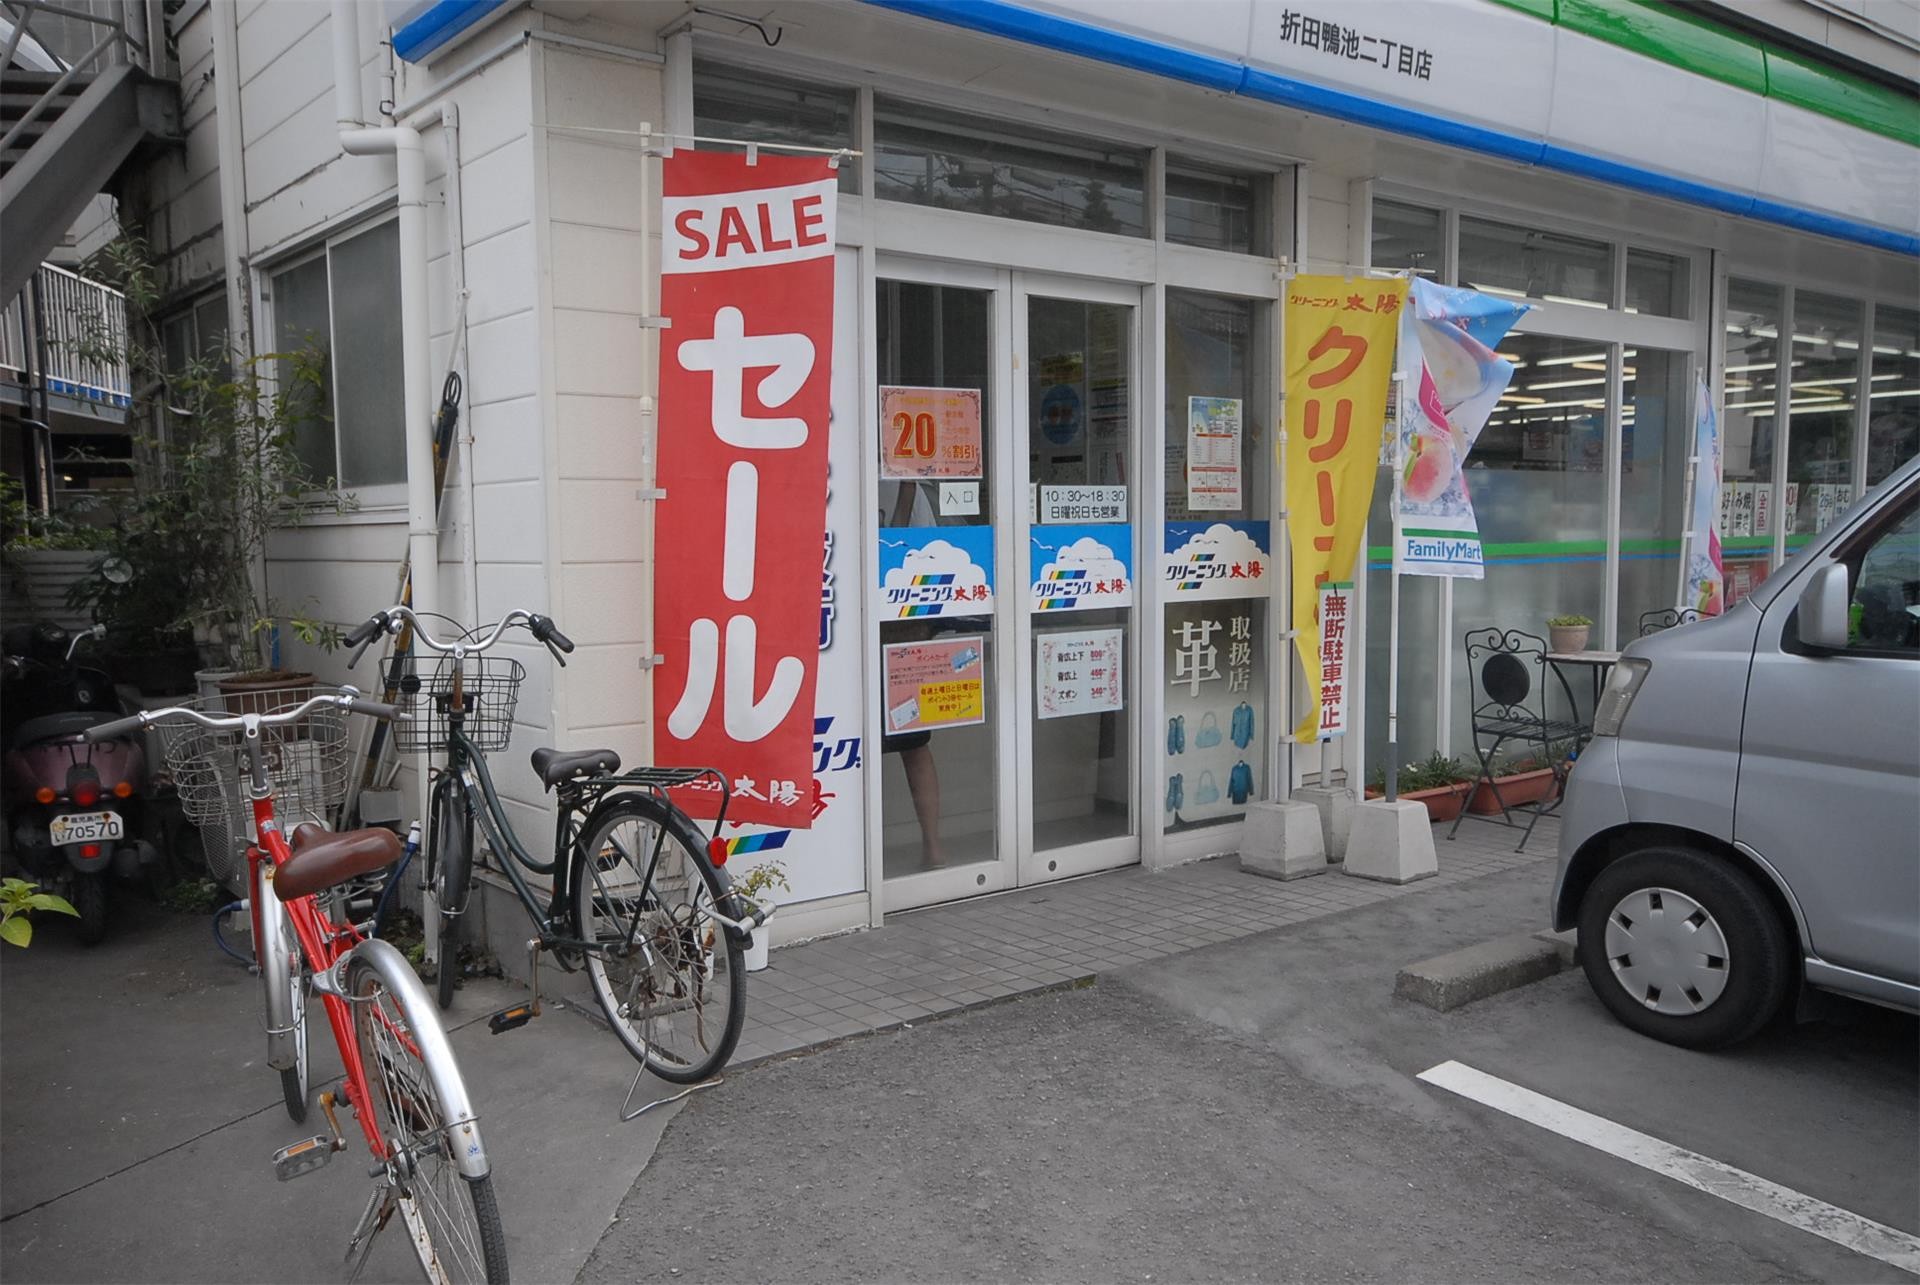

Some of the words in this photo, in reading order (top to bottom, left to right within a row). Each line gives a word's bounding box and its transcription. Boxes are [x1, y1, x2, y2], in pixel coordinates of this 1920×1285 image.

[1280, 9, 1433, 81] 折田鴨池二丁目店
[674, 194, 827, 260] SALE
[892, 411, 937, 459] 20
[667, 306, 816, 743] セール
[946, 490, 974, 504] 入口
[1051, 505, 1120, 519] 日曜祝日も営業
[1407, 539, 1482, 560] FamilyMart
[1170, 619, 1223, 698] 革
[1227, 615, 1252, 694] 取扱店
[1319, 594, 1347, 730] 無断駐車禁止
[65, 821, 119, 840] 70570
